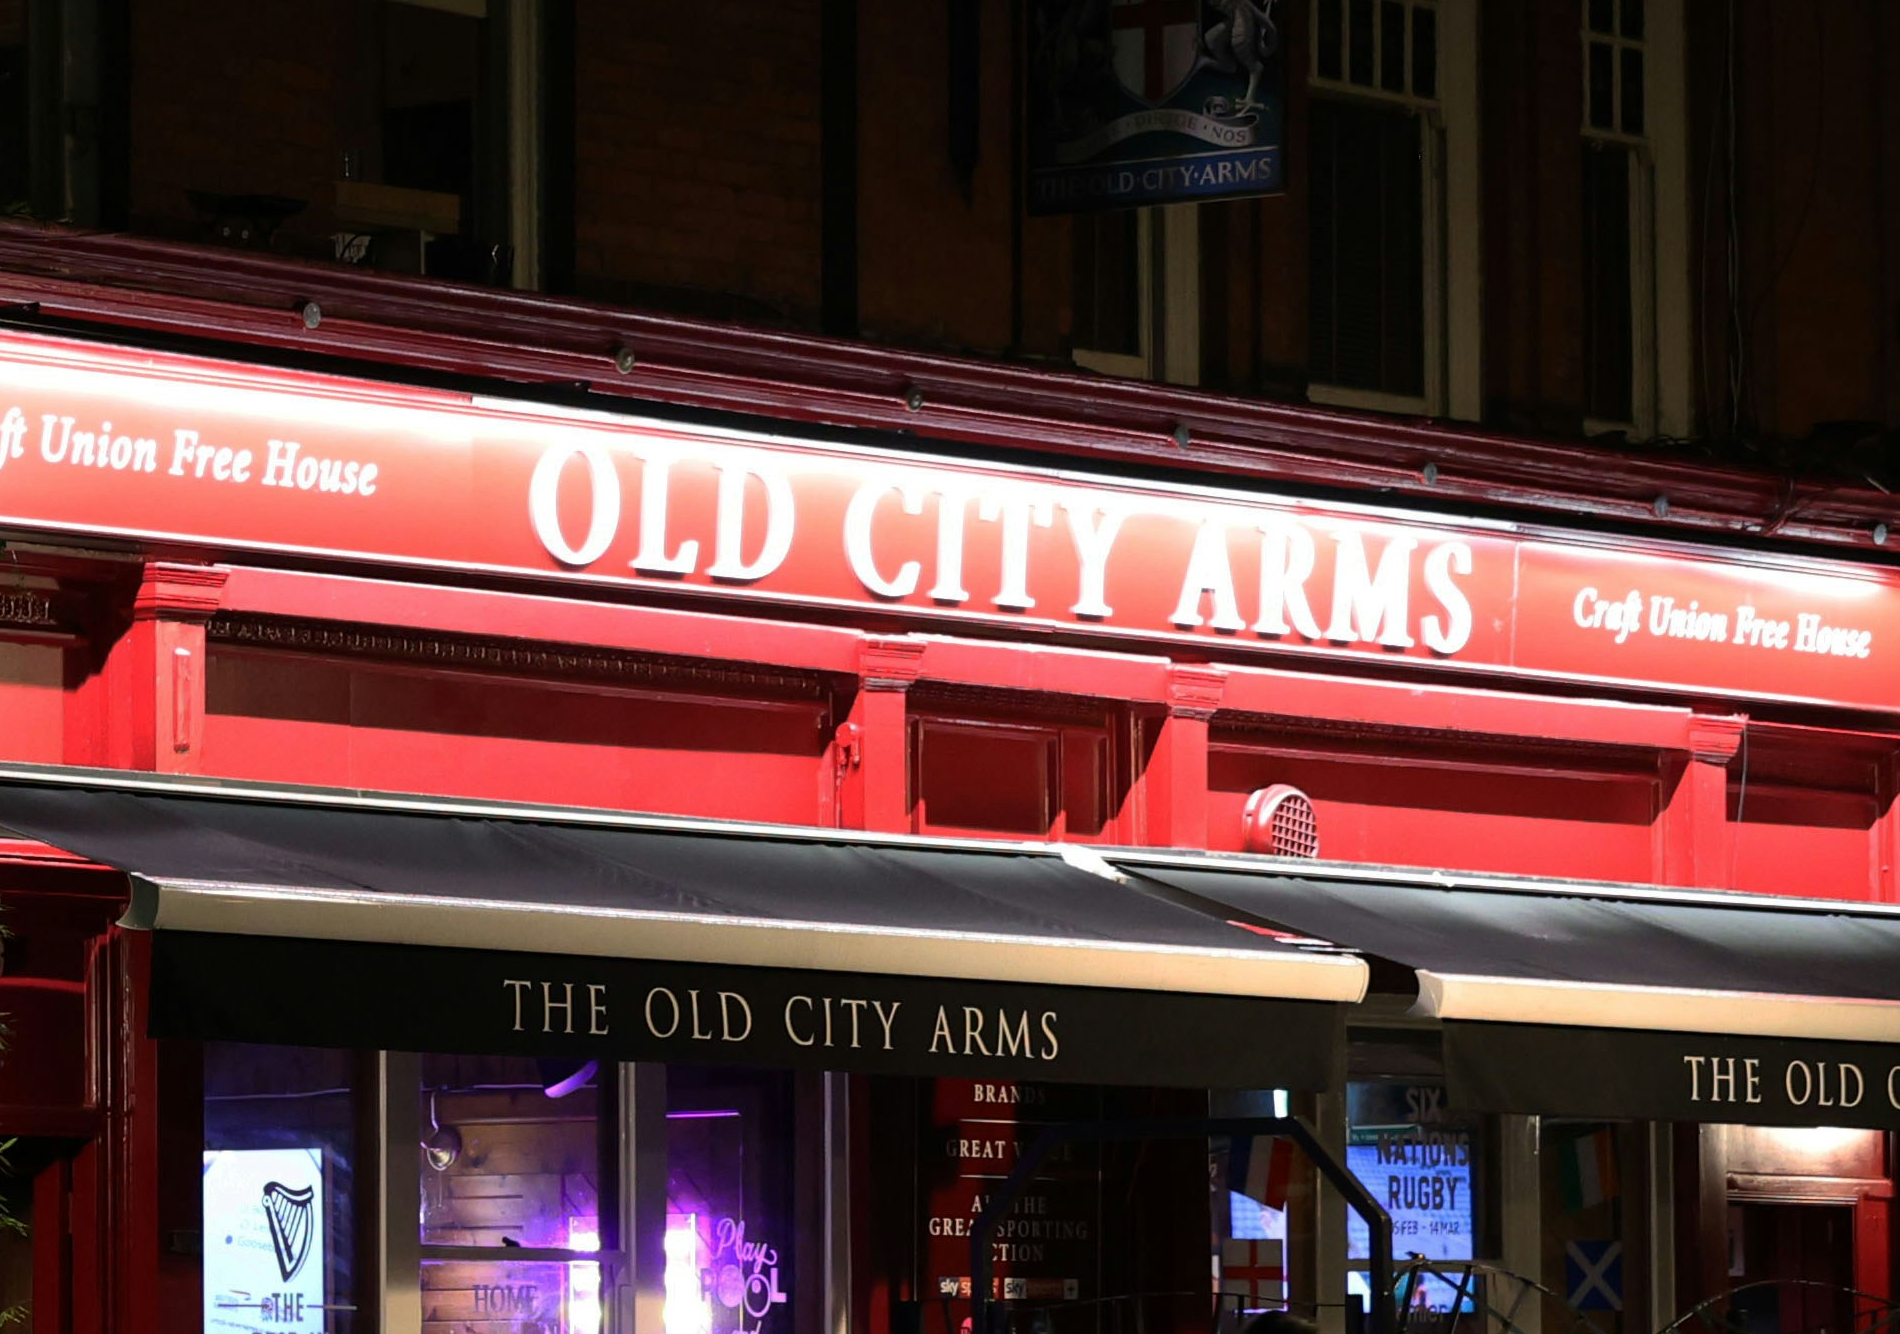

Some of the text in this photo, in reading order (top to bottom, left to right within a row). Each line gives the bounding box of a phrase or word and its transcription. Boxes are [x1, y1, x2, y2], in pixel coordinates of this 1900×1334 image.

[1200, 157, 1272, 185] ARMS
[40, 414, 158, 473] Union
[168, 429, 252, 483] Free
[261, 439, 378, 496] House
[529, 437, 1473, 655] OLD CITY ARMS
[1573, 587, 1872, 658] Craft Union Free House
[503, 979, 1060, 1061] THE OLD CITY ARMS
[973, 1083, 1047, 1105] BRANDS
[1683, 1055, 1763, 1104] THE
[1785, 1060, 1865, 1108] OLD
[1405, 1085, 1443, 1123] SIX
[945, 1138, 1007, 1160] GREAT
[1376, 1131, 1470, 1166] NATIONS
[1388, 1175, 1459, 1210] RUGBY
[713, 1217, 778, 1274] Play
[472, 1284, 538, 1315] HOME
[700, 1264, 788, 1317] POOL
[939, 1278, 959, 1297] sky
[271, 1292, 304, 1323] THE
